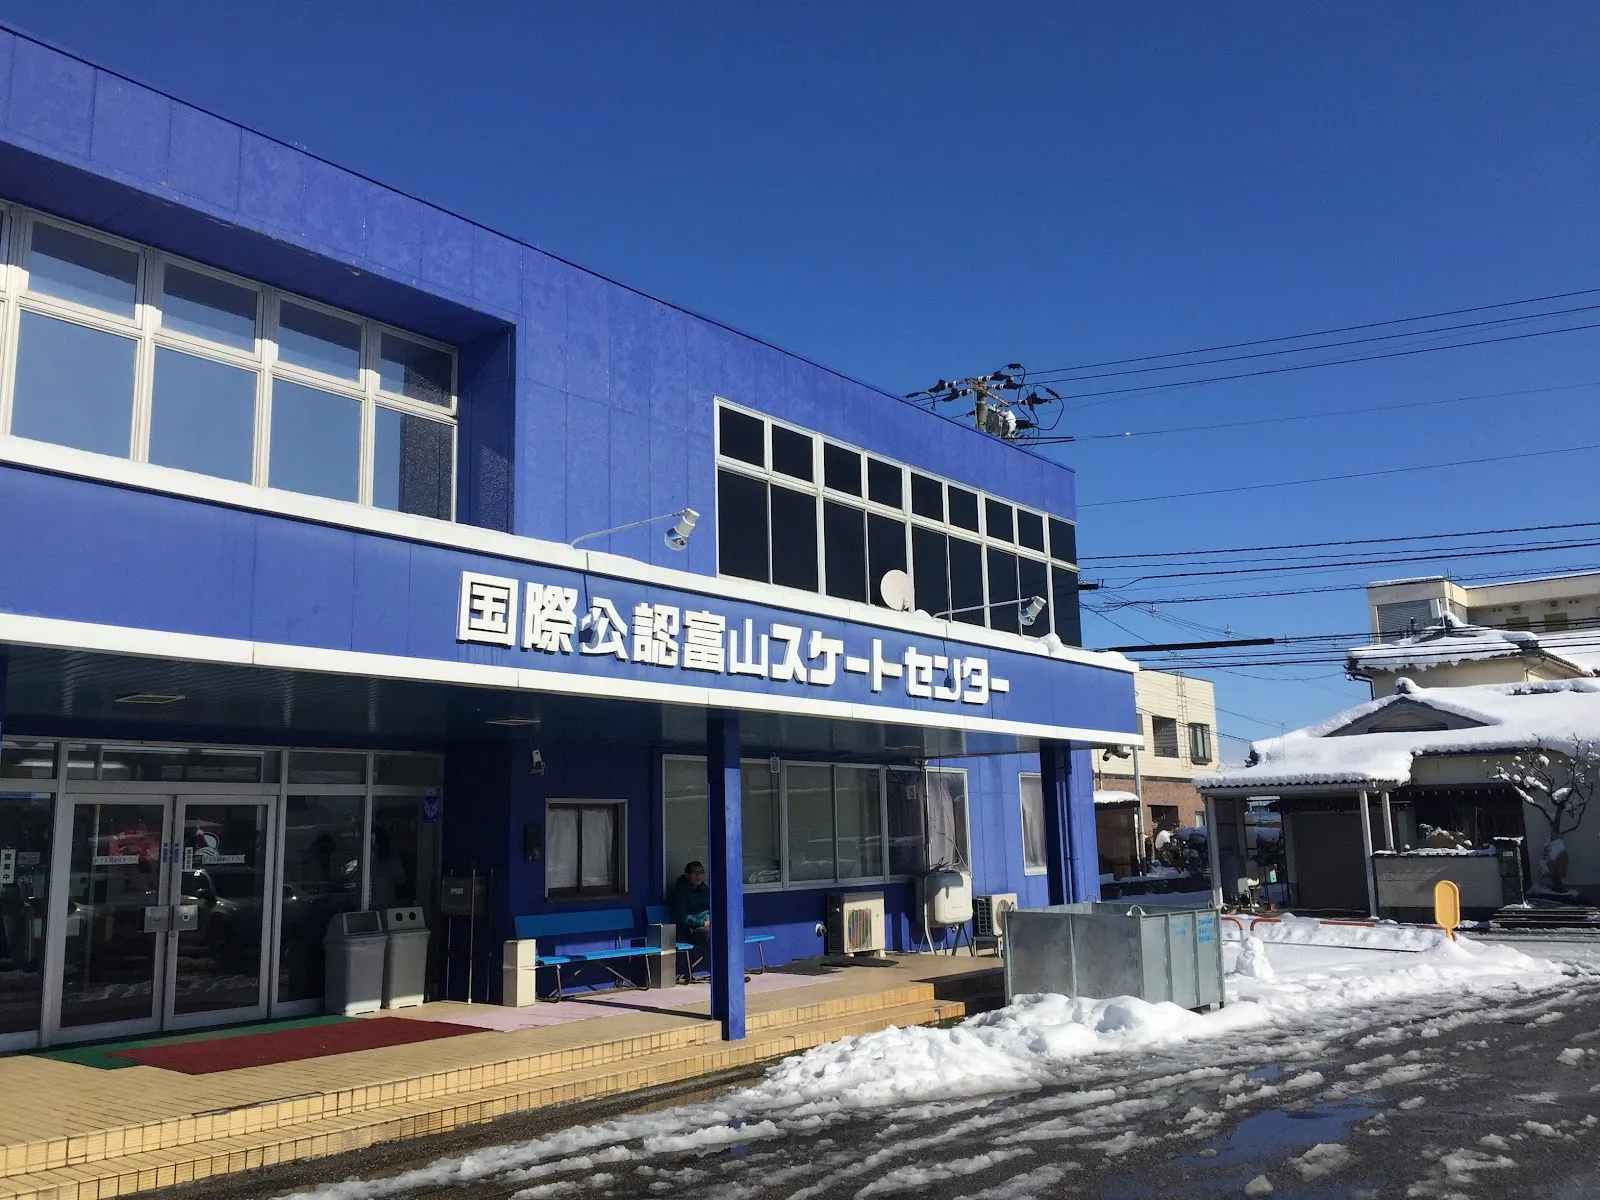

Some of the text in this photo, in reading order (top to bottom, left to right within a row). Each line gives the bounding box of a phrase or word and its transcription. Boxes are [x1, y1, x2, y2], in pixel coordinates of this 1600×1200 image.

[457, 570, 1010, 705] 国際公認富山スケートセンター
